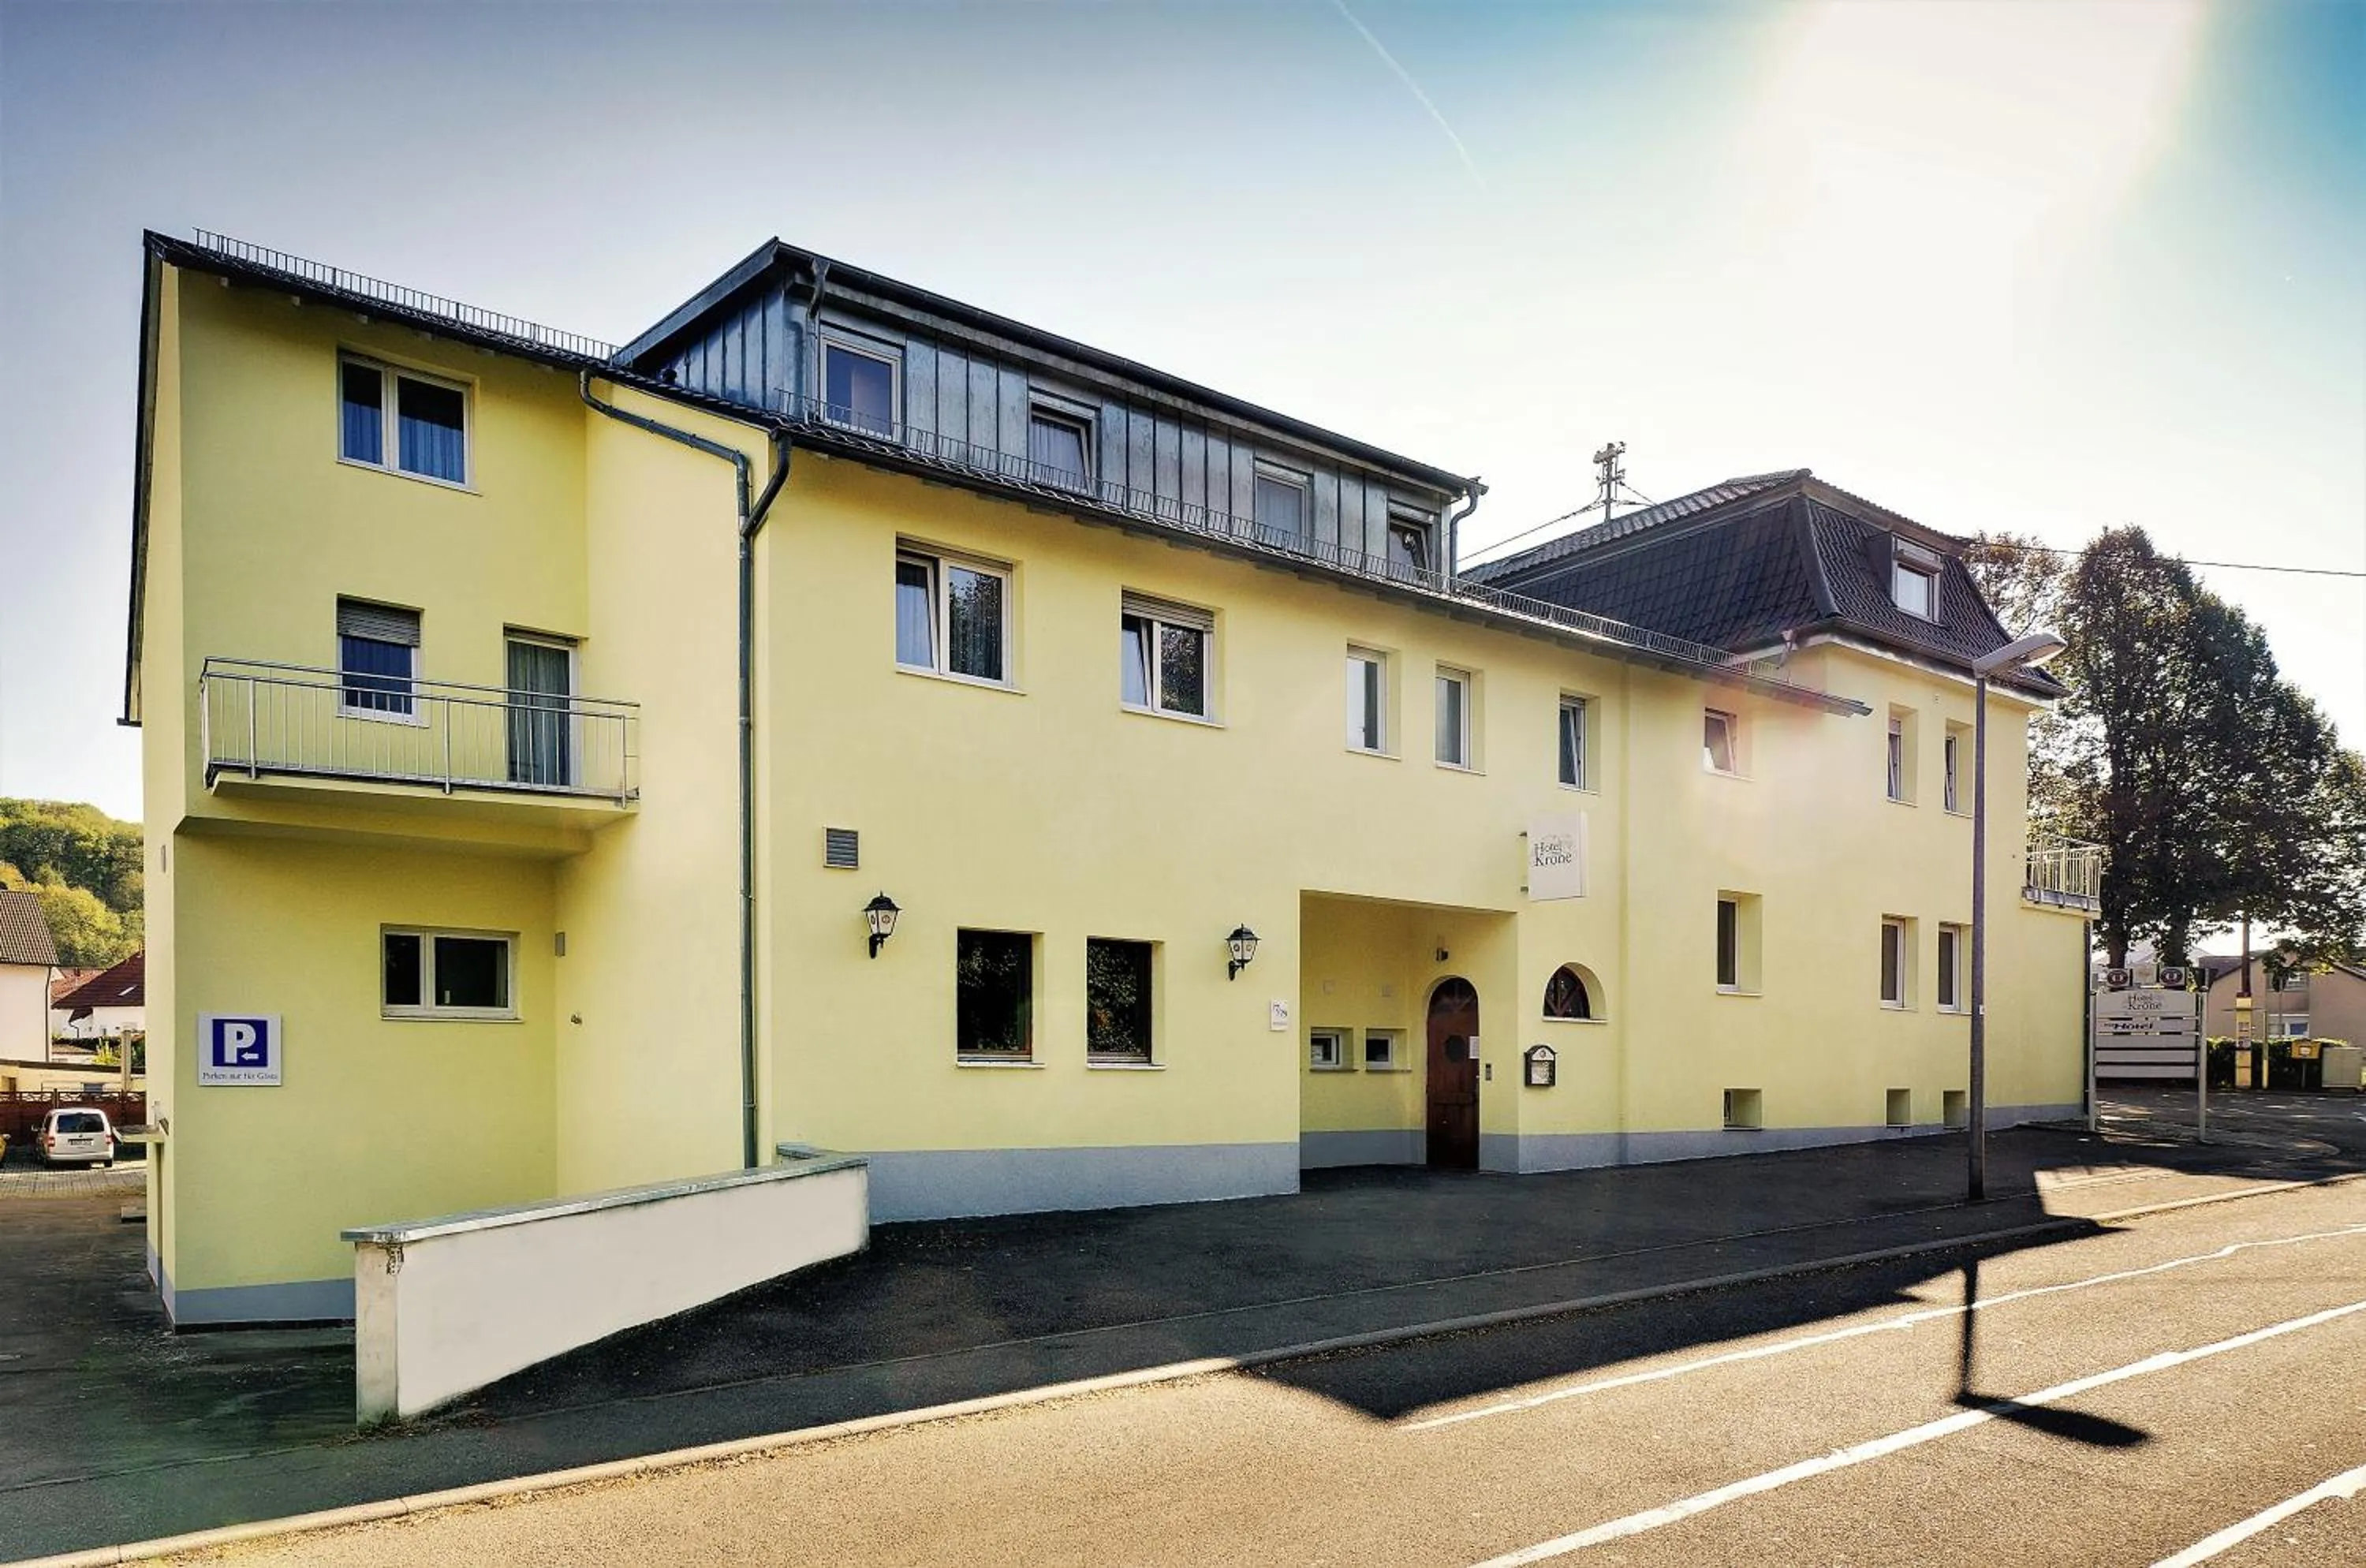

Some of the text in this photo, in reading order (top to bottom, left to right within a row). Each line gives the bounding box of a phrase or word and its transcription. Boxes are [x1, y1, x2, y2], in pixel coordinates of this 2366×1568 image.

[1533, 841, 1562, 853] Hotel
[1533, 853, 1572, 867] Krone
[2128, 993, 2152, 1002] Hotel
[2128, 1002, 2162, 1010] Krone
[224, 1023, 256, 1063] P
